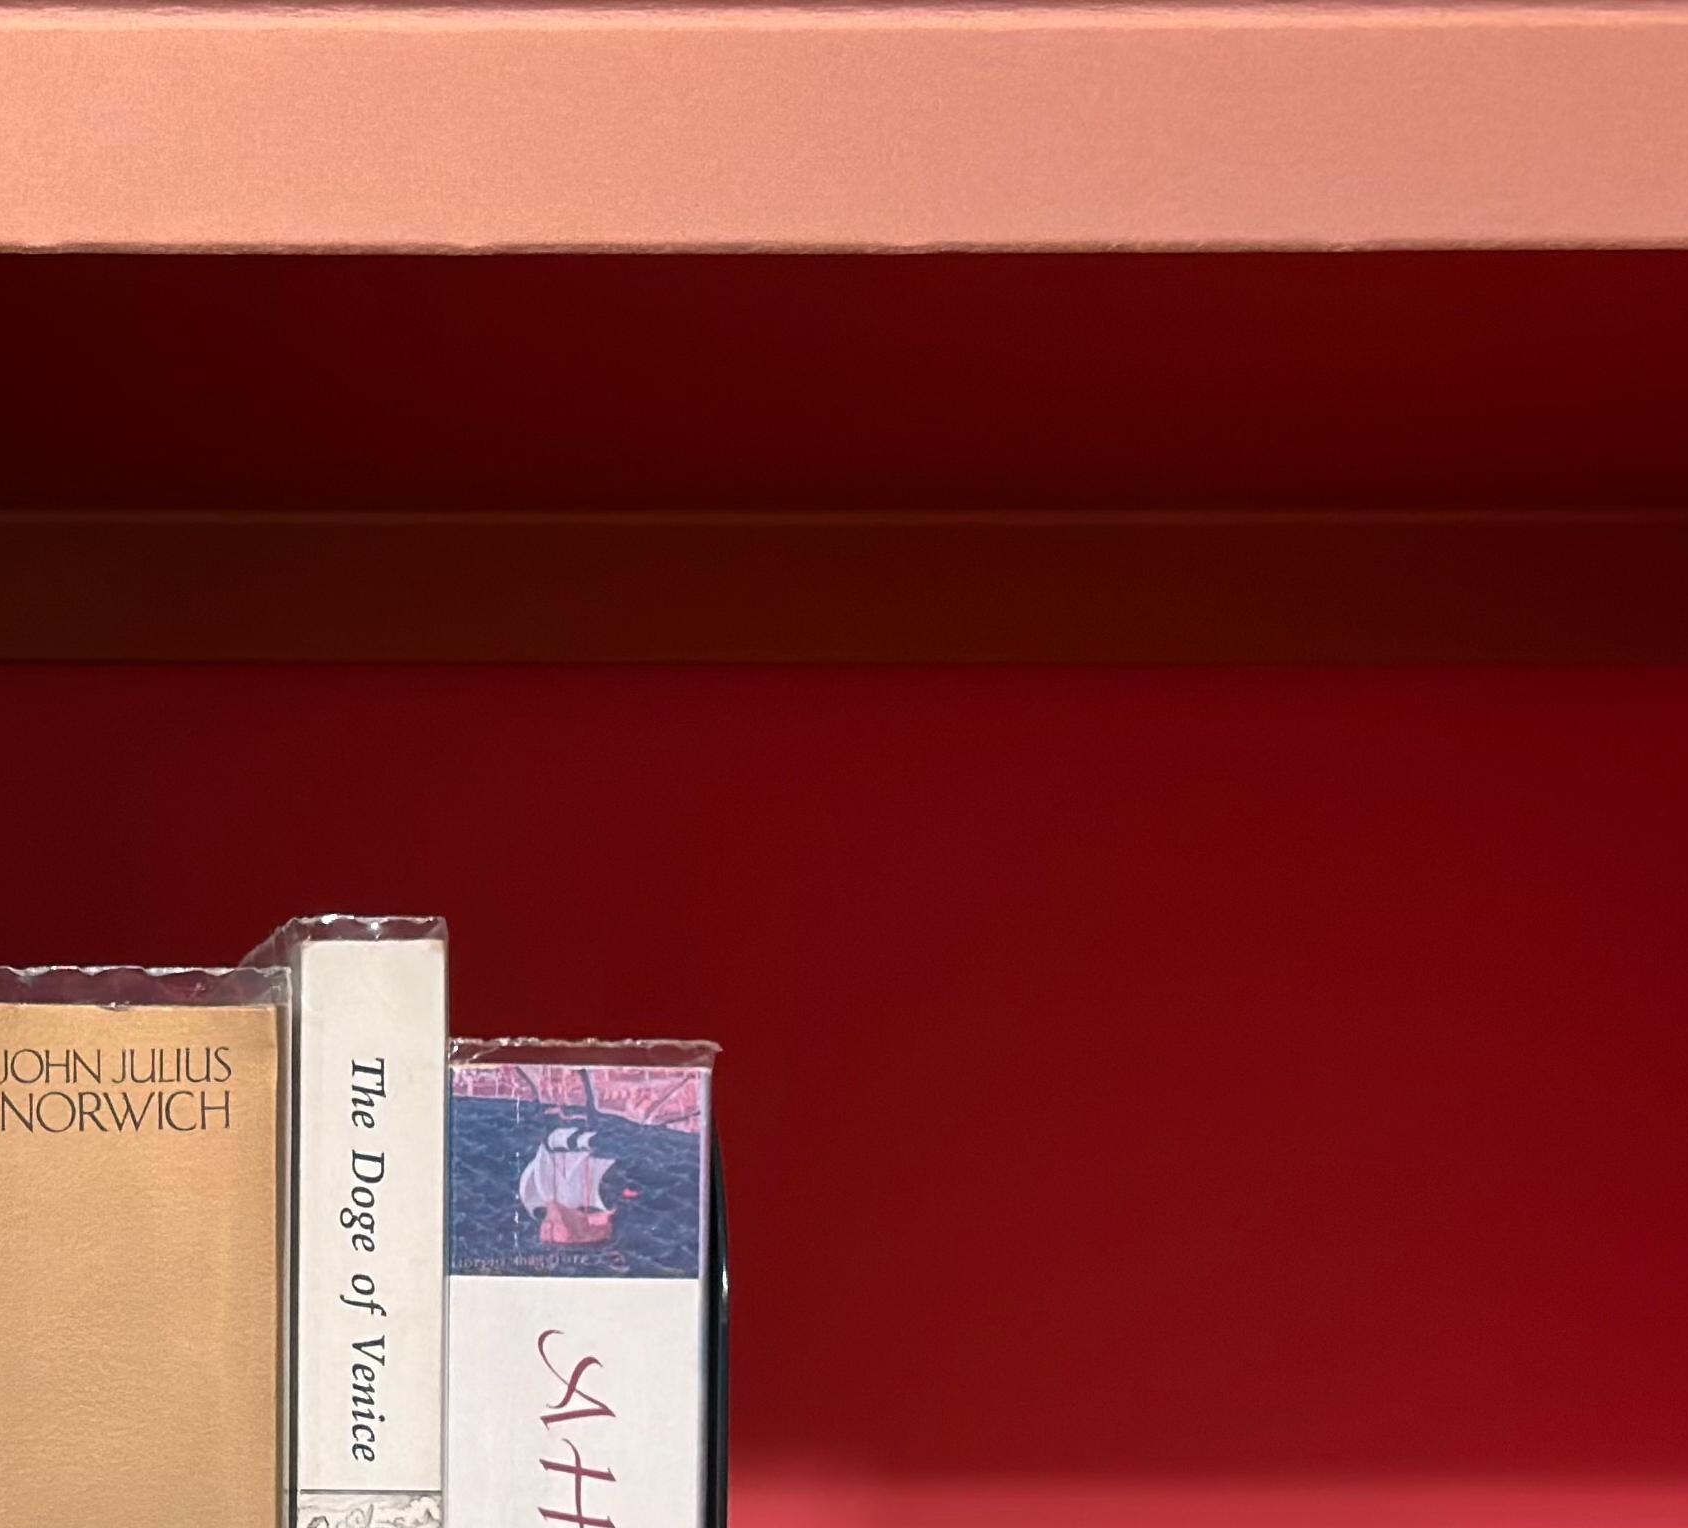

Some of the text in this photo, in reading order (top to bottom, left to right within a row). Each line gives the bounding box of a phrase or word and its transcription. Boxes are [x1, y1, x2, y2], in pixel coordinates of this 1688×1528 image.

[112, 1046, 231, 1083] JULIUS
[1, 1090, 230, 1133] NORWICH
[340, 1058, 386, 1462] The Doge of Venice
[537, 1330, 616, 1431] A
